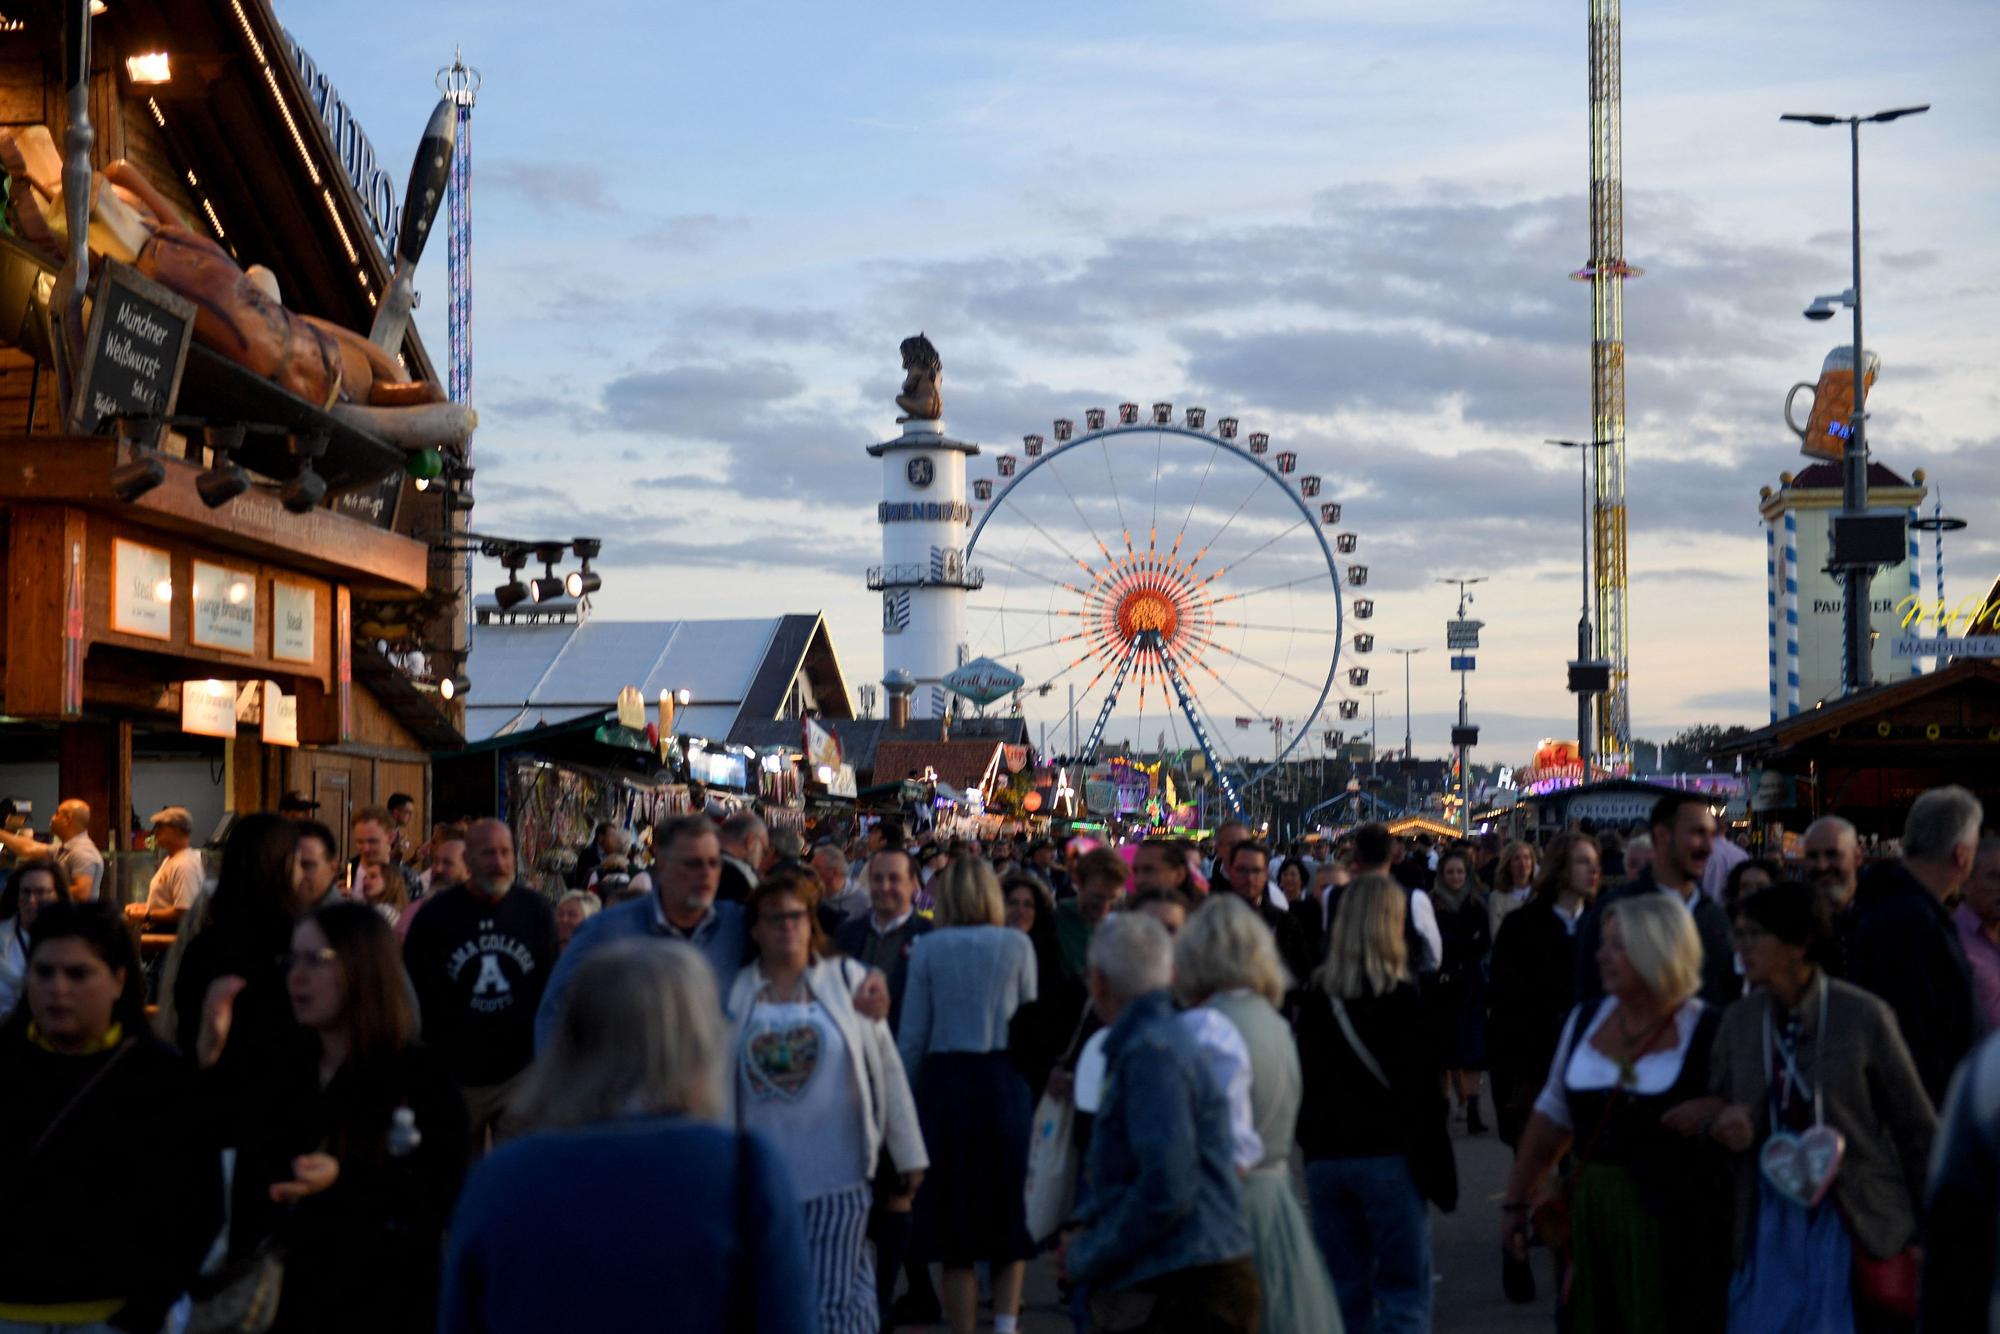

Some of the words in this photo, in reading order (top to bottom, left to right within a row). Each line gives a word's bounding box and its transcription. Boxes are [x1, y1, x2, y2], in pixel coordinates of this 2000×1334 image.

[117, 302, 168, 346] Münchner
[105, 331, 161, 380] Weißwurst
[286, 610, 303, 632] Steak
[1899, 641, 1977, 655] MANDELN
[473, 954, 509, 993] A
[479, 934, 535, 976] COLLEGE
[470, 993, 514, 1013] SCOTS
